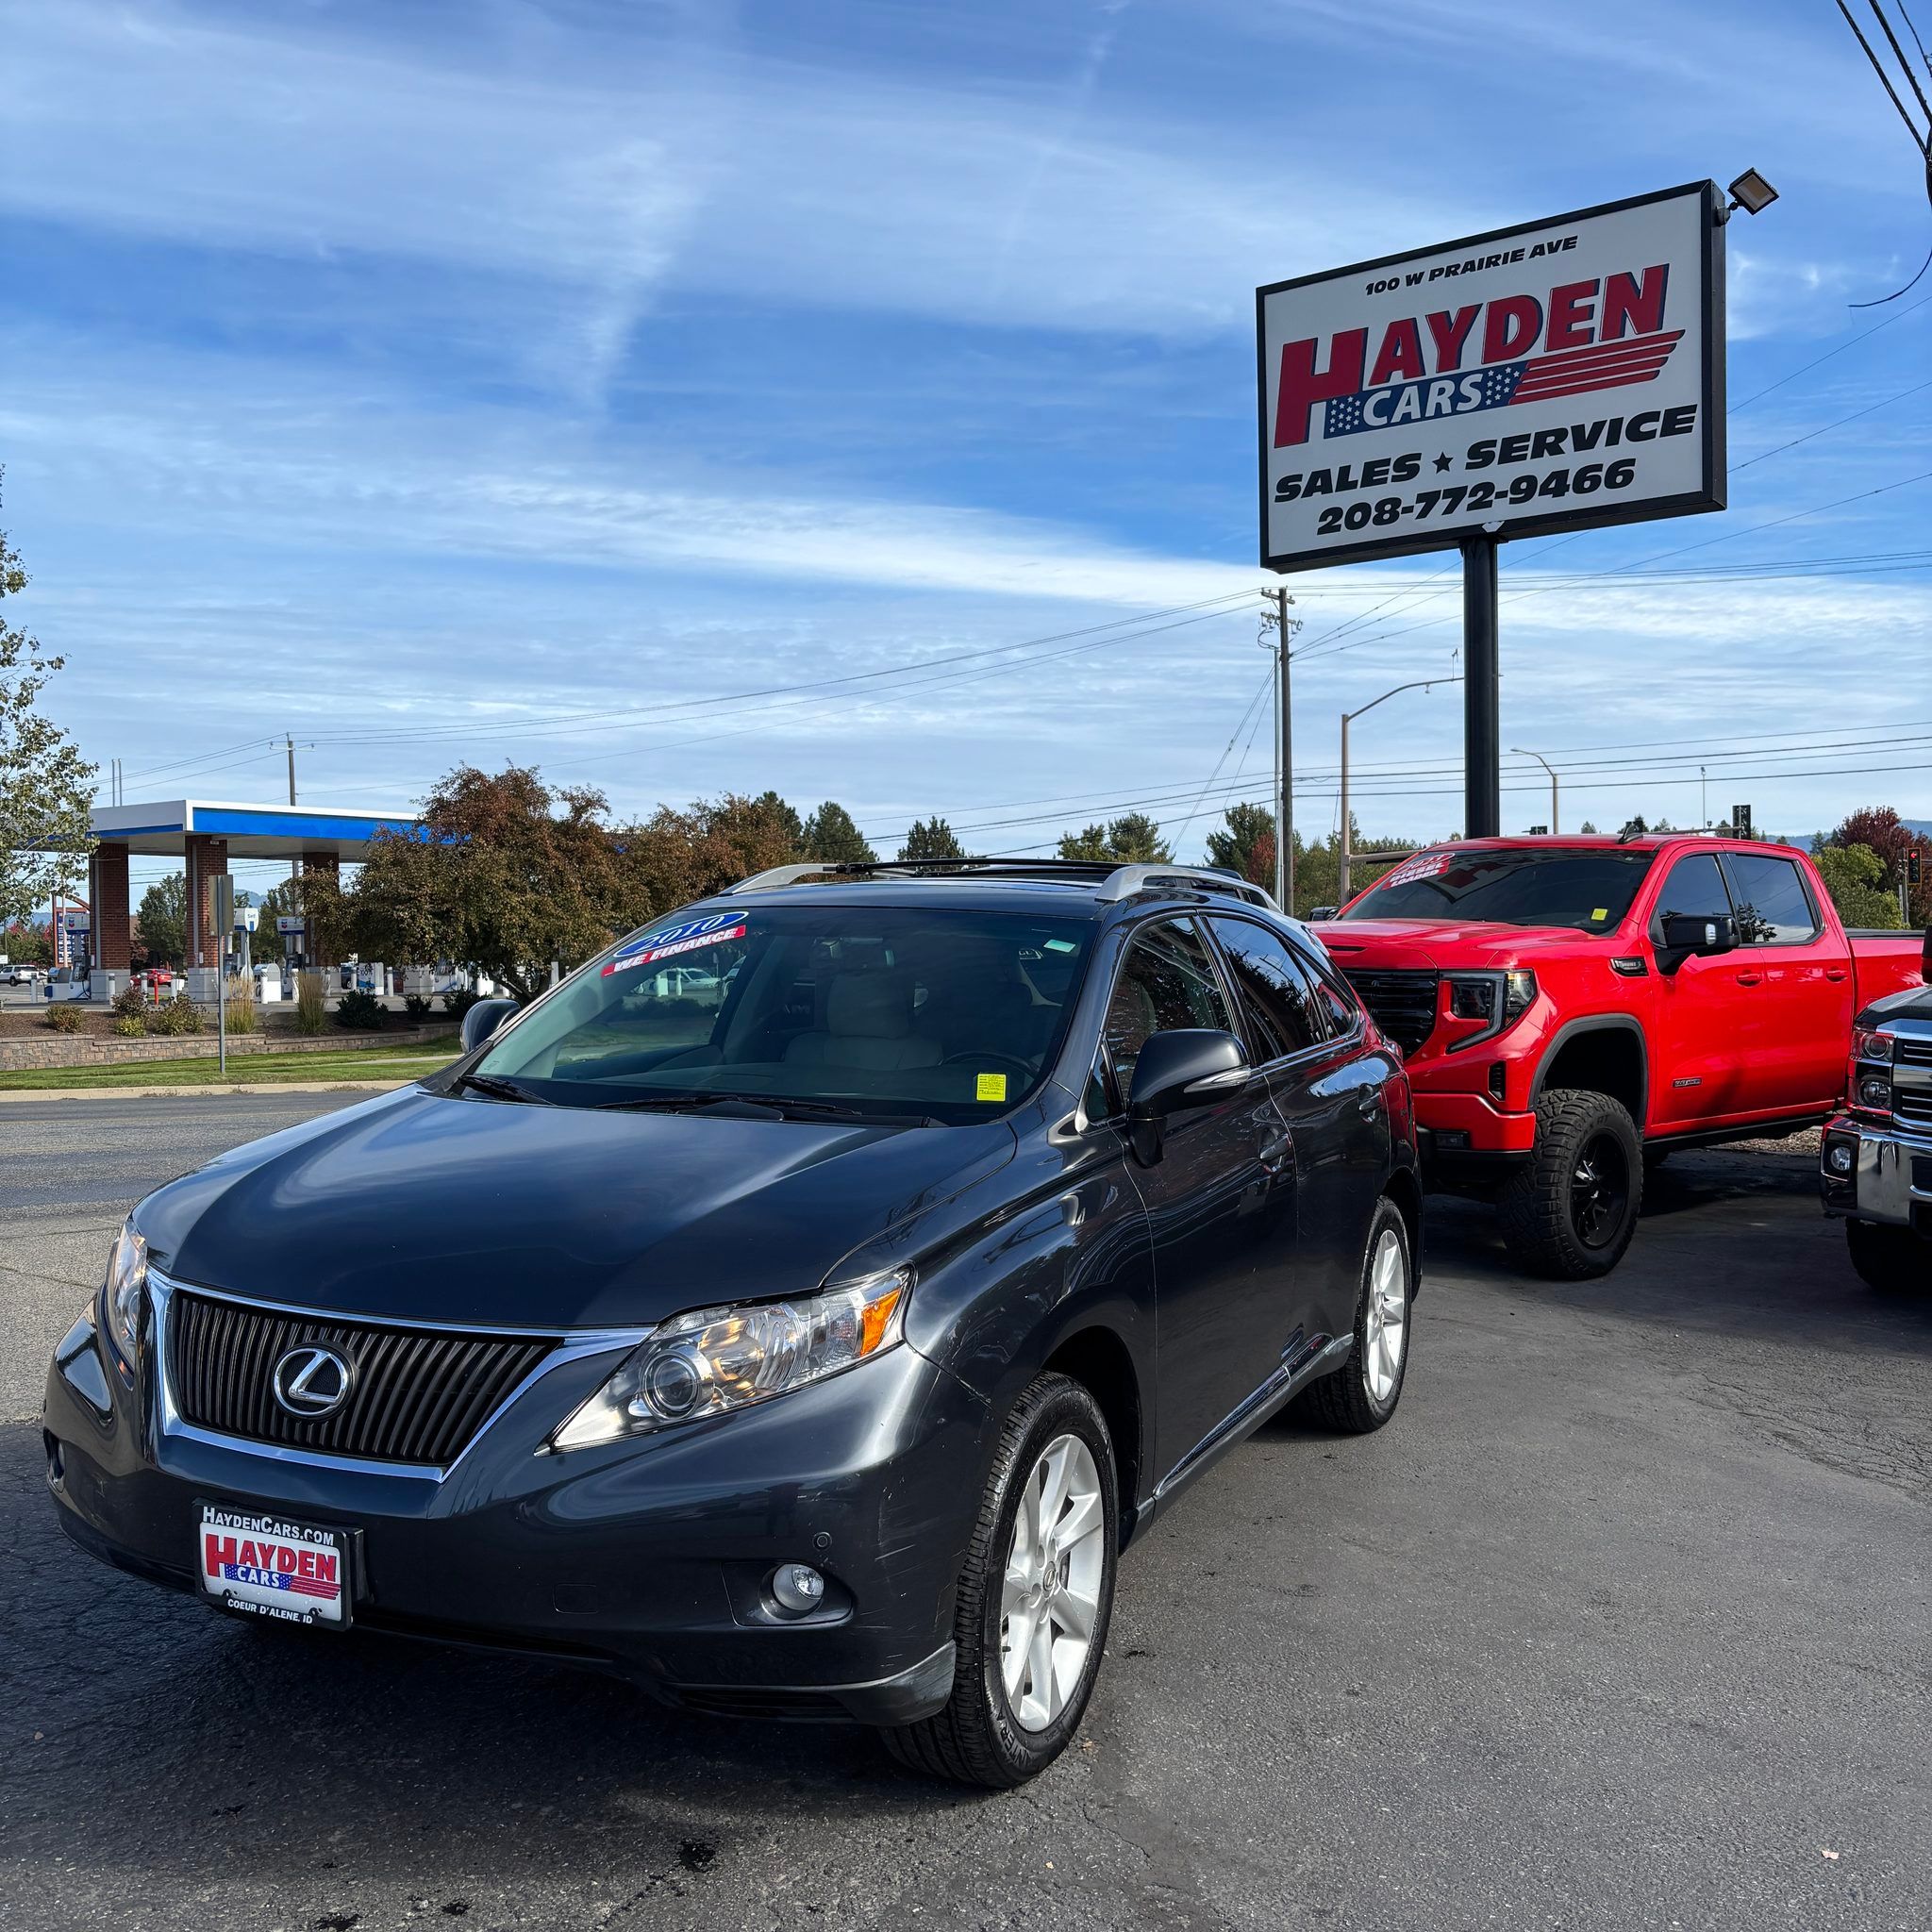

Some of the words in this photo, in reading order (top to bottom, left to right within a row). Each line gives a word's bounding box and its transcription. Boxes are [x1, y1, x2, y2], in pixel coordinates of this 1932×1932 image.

[1365, 276, 1400, 296] 100
[1405, 271, 1425, 287] W
[1428, 247, 1525, 282] PRAIRIE
[1528, 235, 1578, 259] AVE
[1274, 263, 1670, 448] HAYDEN
[1363, 373, 1486, 427] CARS
[1274, 452, 1422, 504] SALES
[1464, 404, 1698, 472] SERVICE
[1316, 458, 1637, 536] 208-772-9466
[1390, 869, 1441, 888] LOADED
[613, 953, 648, 973] WE
[649, 927, 739, 962] FINANCE
[635, 915, 724, 953] 2010
[205, 1533, 338, 1583] HAYDEN
[237, 1566, 280, 1588] CARS
[227, 1598, 258, 1613] COEUR
[303, 1614, 313, 1624] ID
